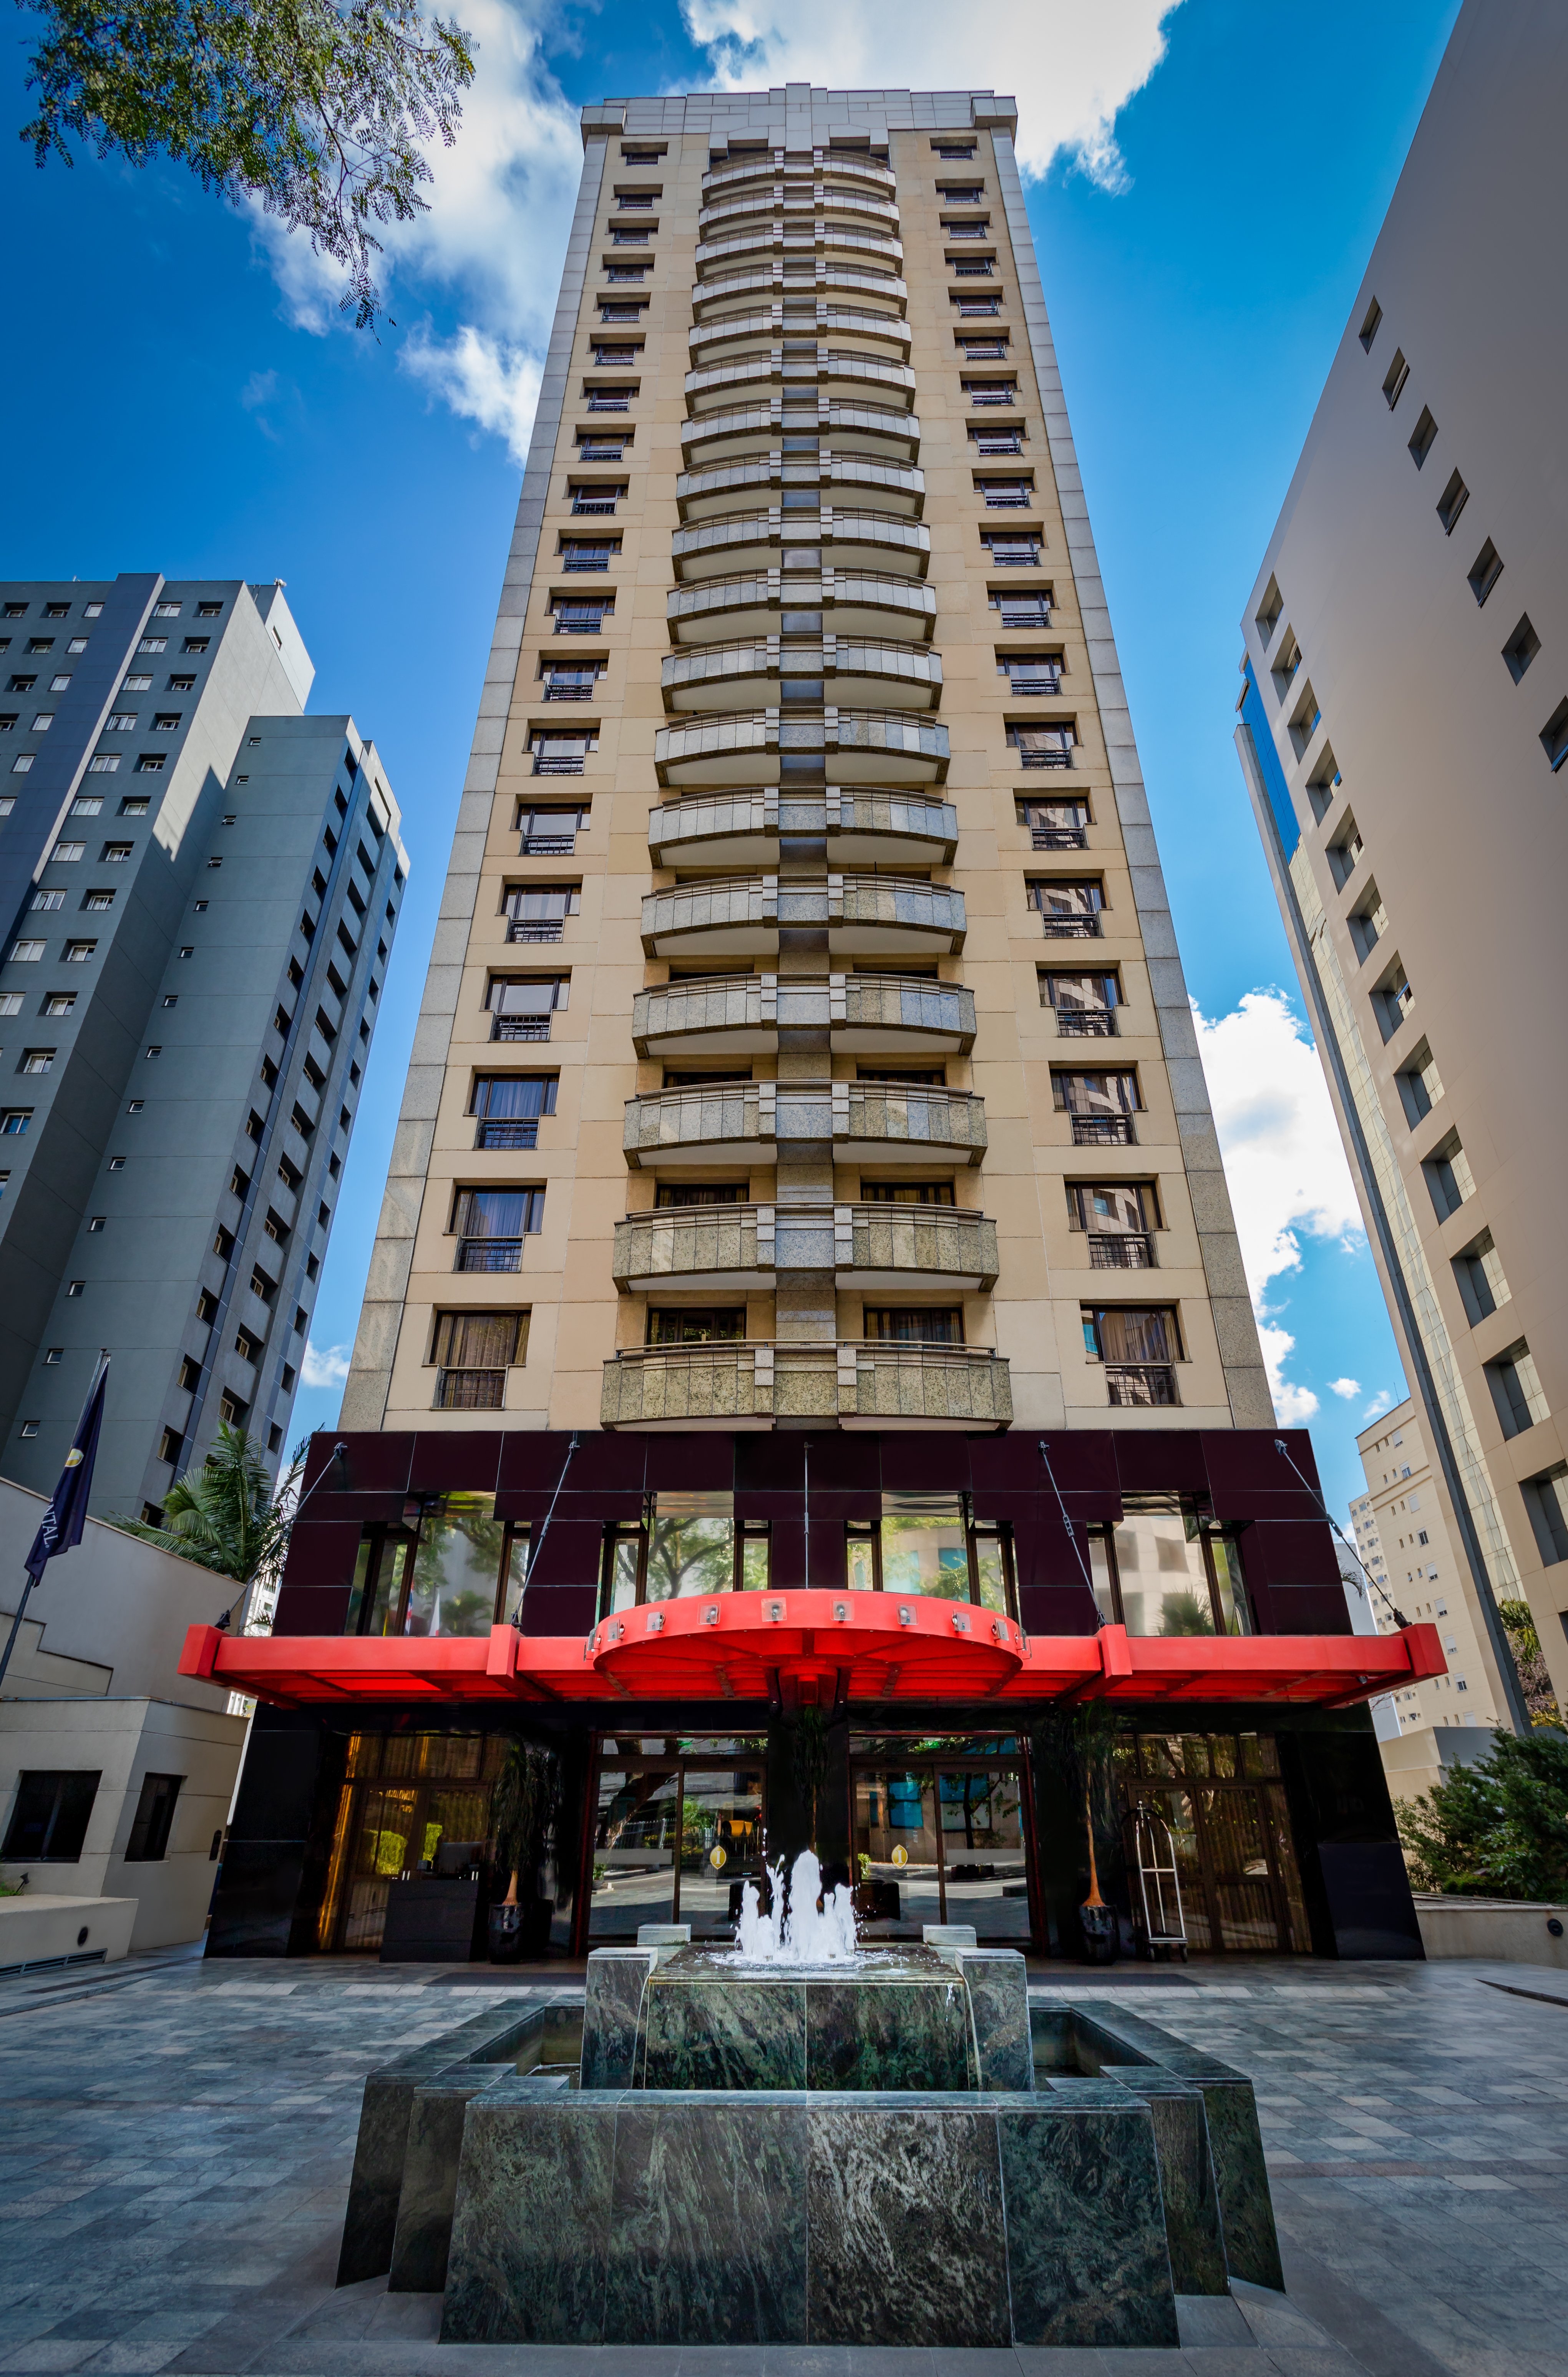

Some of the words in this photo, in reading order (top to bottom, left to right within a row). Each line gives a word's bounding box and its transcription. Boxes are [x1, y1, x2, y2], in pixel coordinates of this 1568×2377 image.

[42, 1498, 58, 1545] NTAL
[714, 1850, 722, 1864] I
[896, 1850, 904, 1863] I
